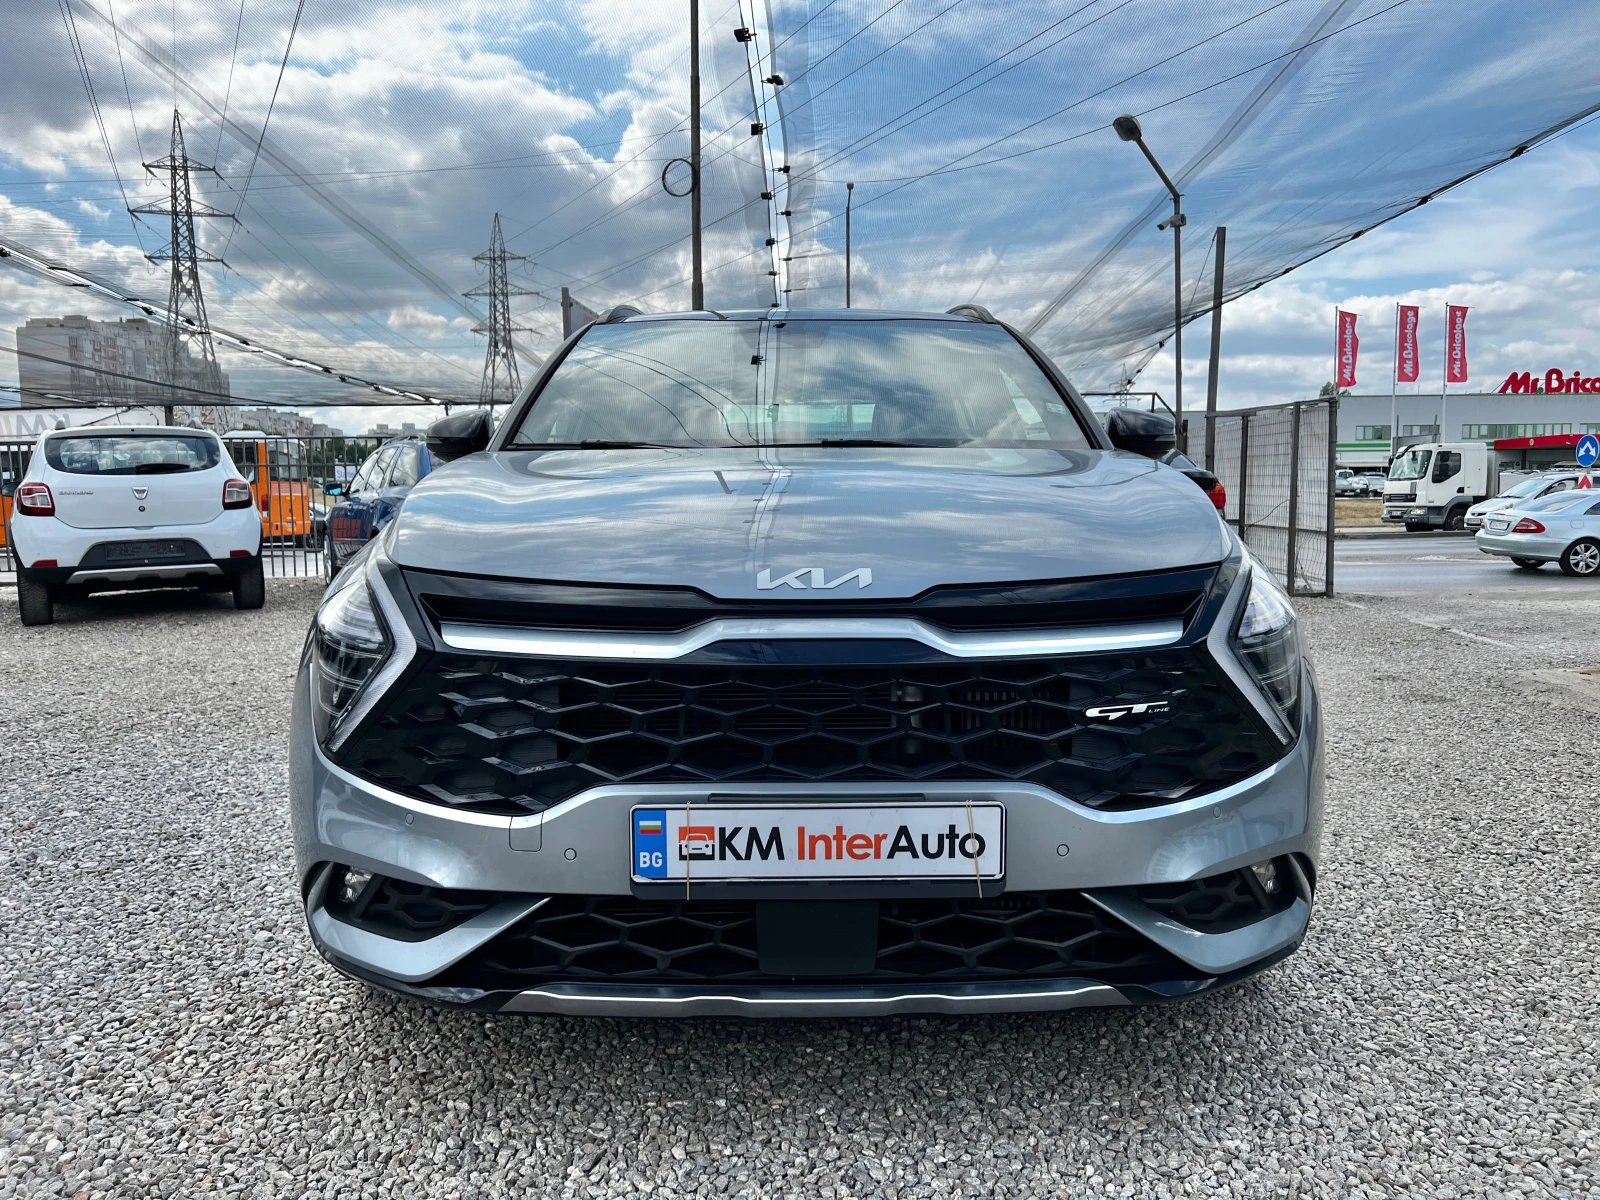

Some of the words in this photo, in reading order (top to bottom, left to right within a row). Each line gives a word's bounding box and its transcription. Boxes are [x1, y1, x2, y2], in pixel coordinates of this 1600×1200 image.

[756, 567, 873, 590] KIA
[718, 826, 785, 861] KM
[639, 852, 663, 868] BG
